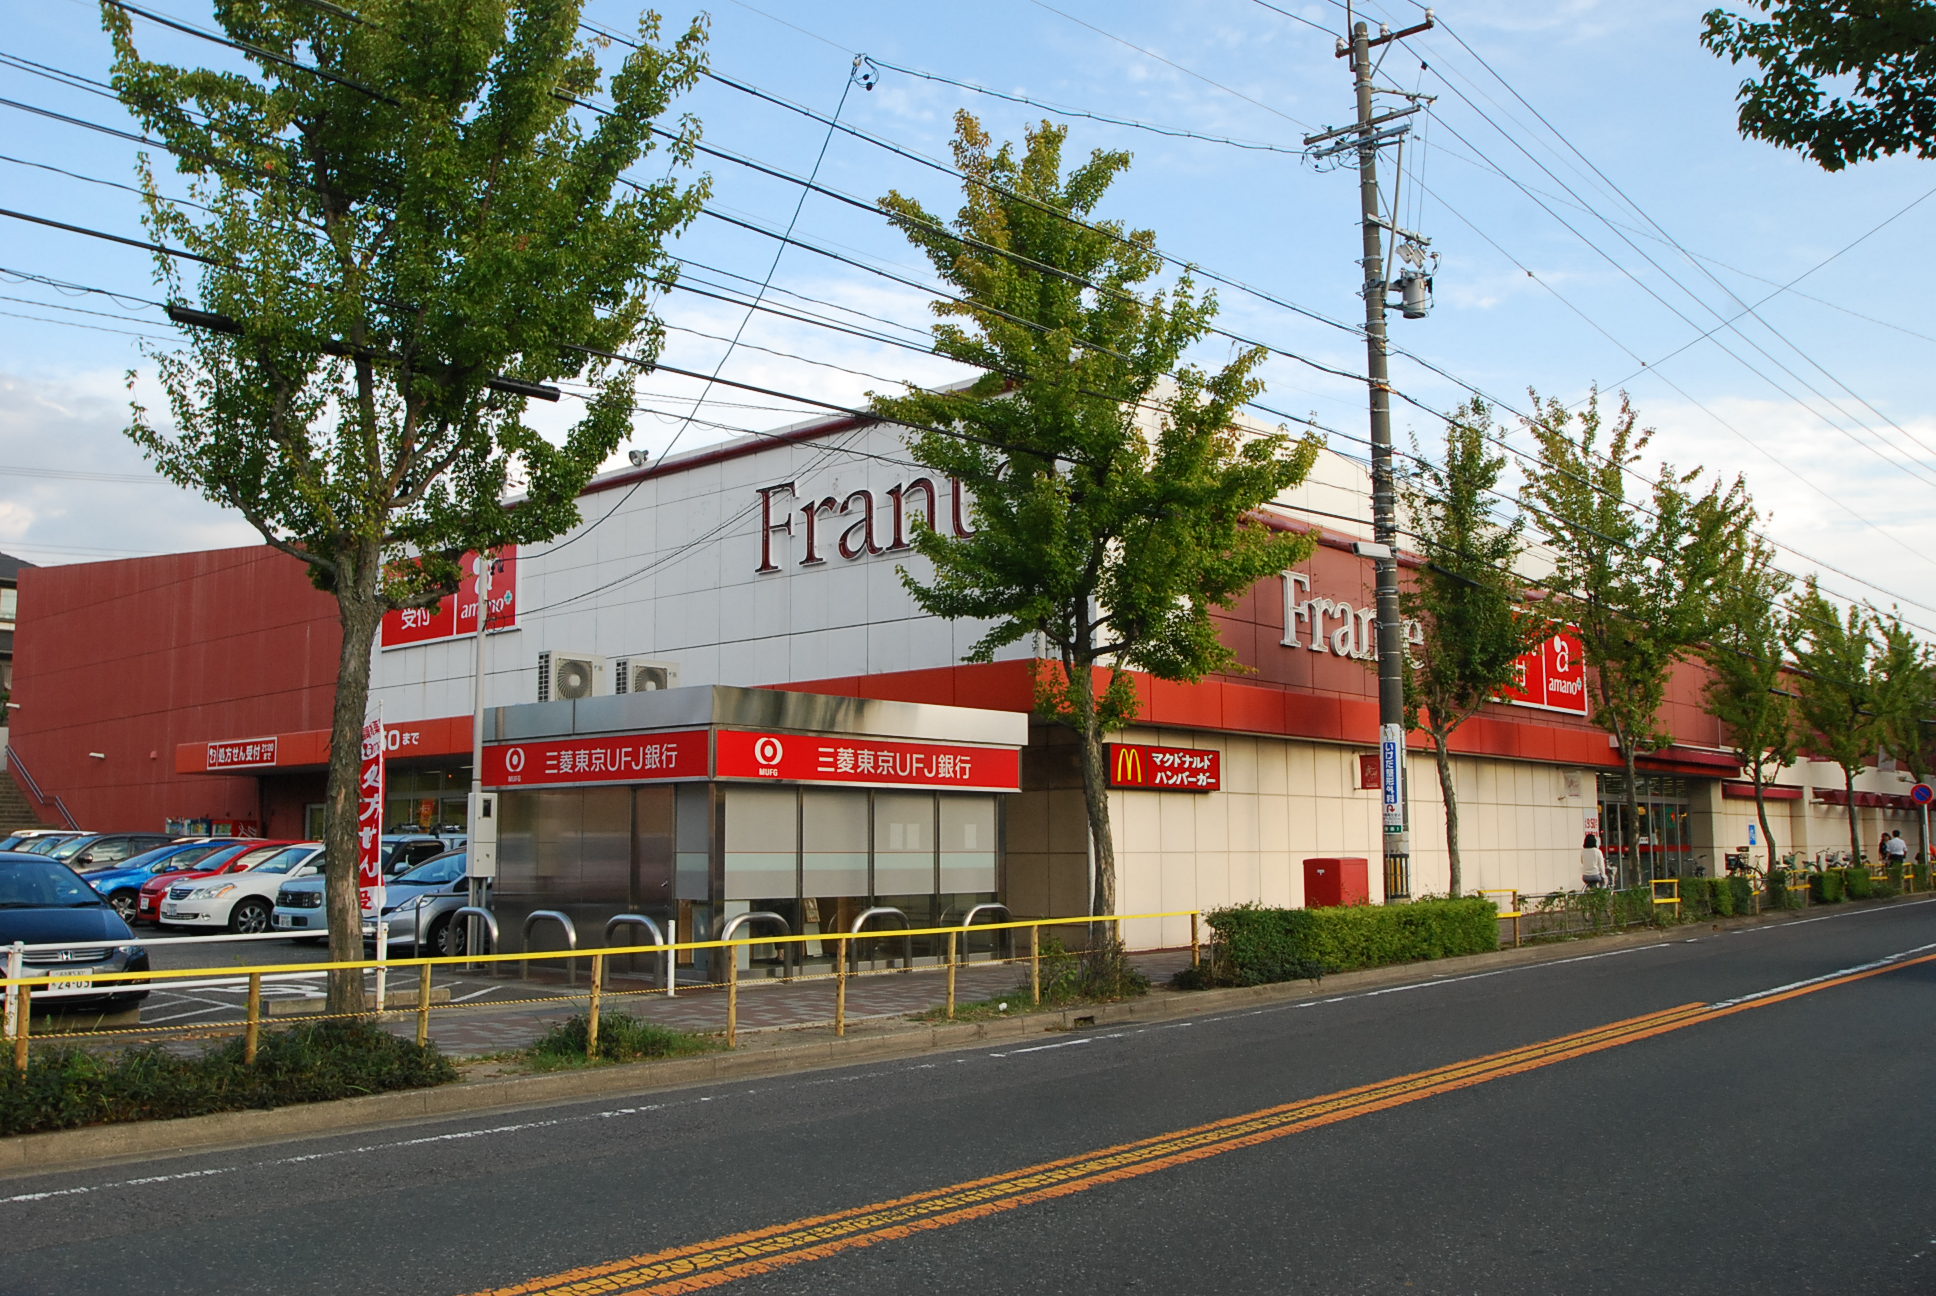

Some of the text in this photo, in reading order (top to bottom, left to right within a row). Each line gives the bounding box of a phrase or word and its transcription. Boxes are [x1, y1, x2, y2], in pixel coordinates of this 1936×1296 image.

[460, 597, 505, 620] amno
[401, 606, 430, 631] 受付
[1280, 569, 1426, 671] Frane
[1548, 677, 1577, 696] amano
[218, 745, 261, 764] 処方せん受付
[545, 743, 678, 775] 三菱東京UFJ銀行
[816, 746, 972, 780] 三菱東京UFJ銀行
[1151, 752, 1214, 770] マクドナルド
[507, 775, 522, 783] MUFG
[758, 768, 779, 777] MUFG
[1154, 770, 1216, 787] ハンバーガー
